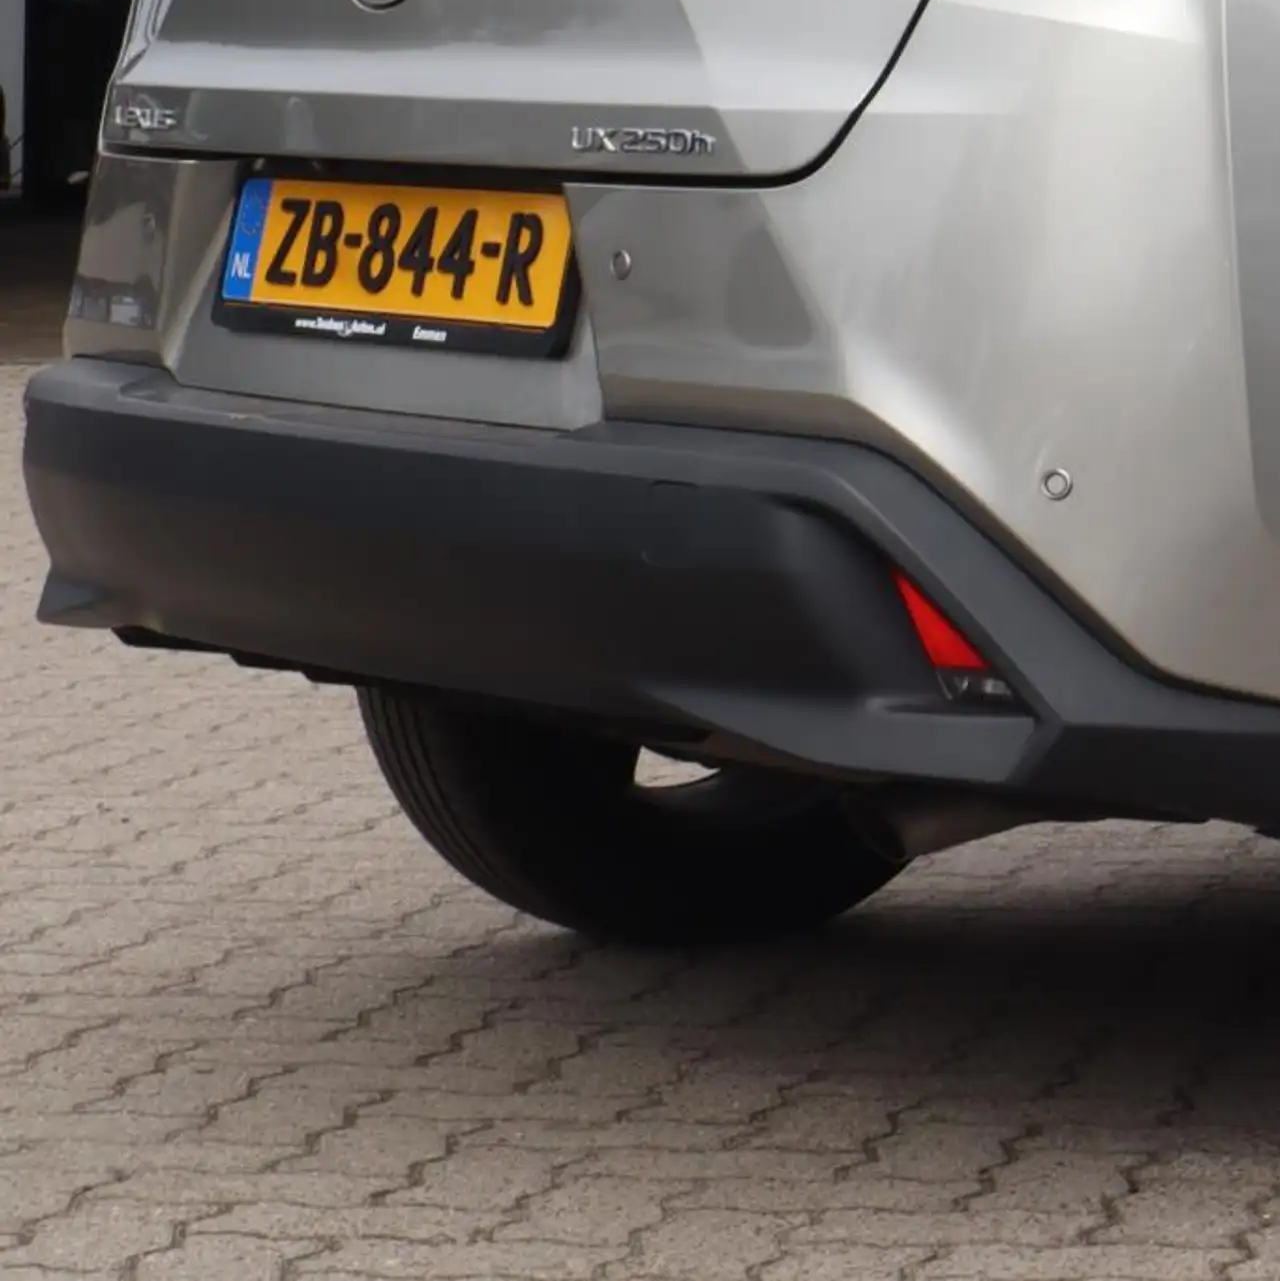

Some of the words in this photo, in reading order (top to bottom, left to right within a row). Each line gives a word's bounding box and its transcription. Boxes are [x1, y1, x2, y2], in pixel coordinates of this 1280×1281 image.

[571, 125, 617, 152] UX
[620, 127, 716, 154] 250h
[231, 252, 250, 278] NL
[265, 197, 544, 307] ZB-844-R
